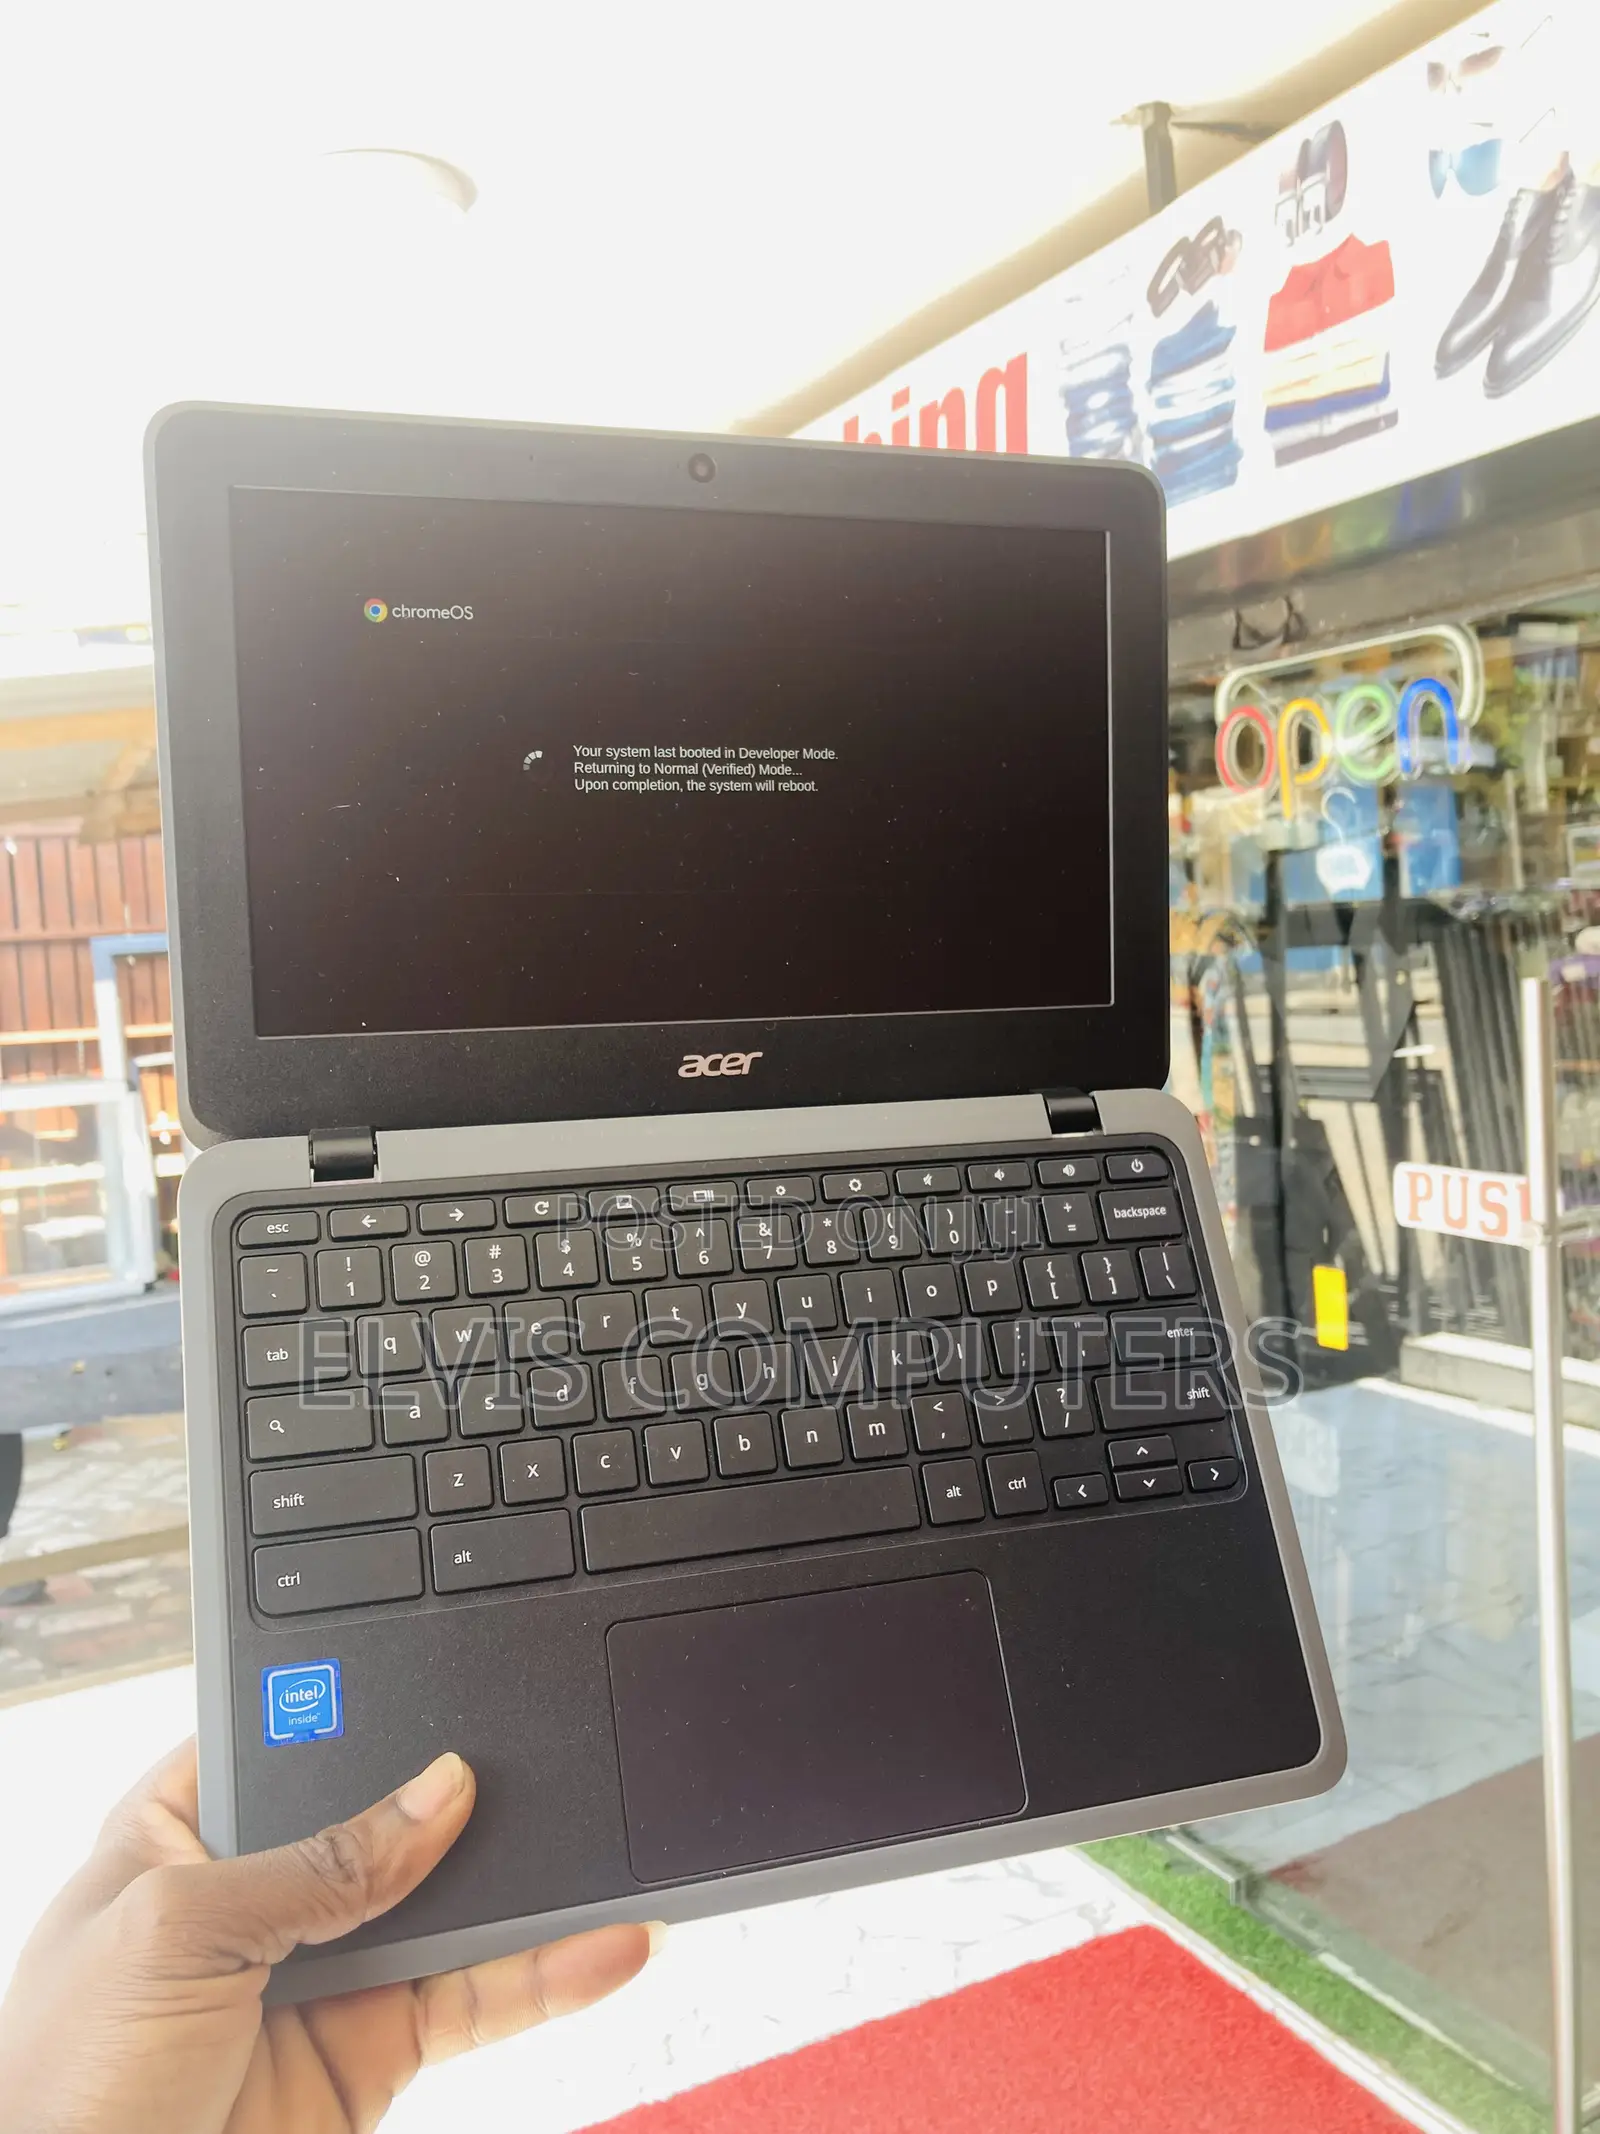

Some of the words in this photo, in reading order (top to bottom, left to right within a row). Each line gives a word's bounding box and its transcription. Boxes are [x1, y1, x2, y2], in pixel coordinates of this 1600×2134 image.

[392, 604, 474, 620] chromeOS
[573, 745, 602, 757] Your
[606, 746, 651, 760] system
[654, 746, 676, 758] last
[680, 746, 721, 759] booted
[724, 747, 736, 759] in
[739, 747, 800, 762] Developer
[803, 748, 839, 760] Mode.
[1215, 677, 1470, 820] open
[574, 762, 635, 777] Returning
[639, 763, 651, 774] to
[654, 763, 699, 774] Normal
[702, 763, 756, 778] (Verified)
[759, 764, 803, 776] Mode...
[574, 779, 609, 793] Upon
[612, 779, 683, 793] completion,
[687, 779, 706, 791] the
[709, 780, 753, 794] system
[755, 780, 775, 792] will
[778, 780, 819, 792] reboot.
[678, 1051, 763, 1078] acer
[1113, 1205, 1167, 1219] backspace
[267, 1222, 289, 1234] esc
[889, 1235, 899, 1249] 9
[950, 1231, 959, 1244] 0
[763, 1245, 773, 1259] 7
[827, 1240, 837, 1254] 8
[632, 1256, 642, 1271] 5
[699, 1251, 709, 1265] 6
[492, 1269, 503, 1283] 3
[563, 1263, 574, 1276] 4
[419, 1275, 430, 1290] 2
[987, 1279, 998, 1297] p
[867, 1288, 872, 1302] i
[926, 1285, 937, 1297] o
[802, 1297, 813, 1308] u
[671, 1307, 680, 1320] t
[736, 1302, 747, 1319] y
[531, 1320, 542, 1335] e
[603, 1315, 611, 1328] r
[455, 1328, 472, 1343] w
[1166, 1326, 1195, 1339] enter
[384, 1336, 397, 1354] q
[266, 1348, 288, 1362] tab
[891, 1350, 902, 1366] k
[763, 1362, 775, 1379] h
[831, 1356, 838, 1376] j
[627, 1377, 637, 1395] f
[697, 1372, 708, 1391] g
[557, 1384, 568, 1402] d
[1187, 1386, 1210, 1400] shift
[484, 1396, 495, 1411] s
[409, 1404, 421, 1419] a
[868, 1421, 886, 1436] m
[738, 1434, 750, 1451] b
[806, 1430, 818, 1443] n
[670, 1446, 682, 1460] v
[600, 1455, 611, 1469] c
[526, 1463, 540, 1478] x
[453, 1473, 464, 1487] z
[1008, 1477, 1027, 1490] ctrl
[946, 1485, 962, 1499] alt
[273, 1493, 305, 1509] shift
[453, 1550, 473, 1564] alt
[277, 1572, 301, 1588] ctrl
[284, 1684, 319, 1704] intel
[288, 1712, 319, 1726] inside
